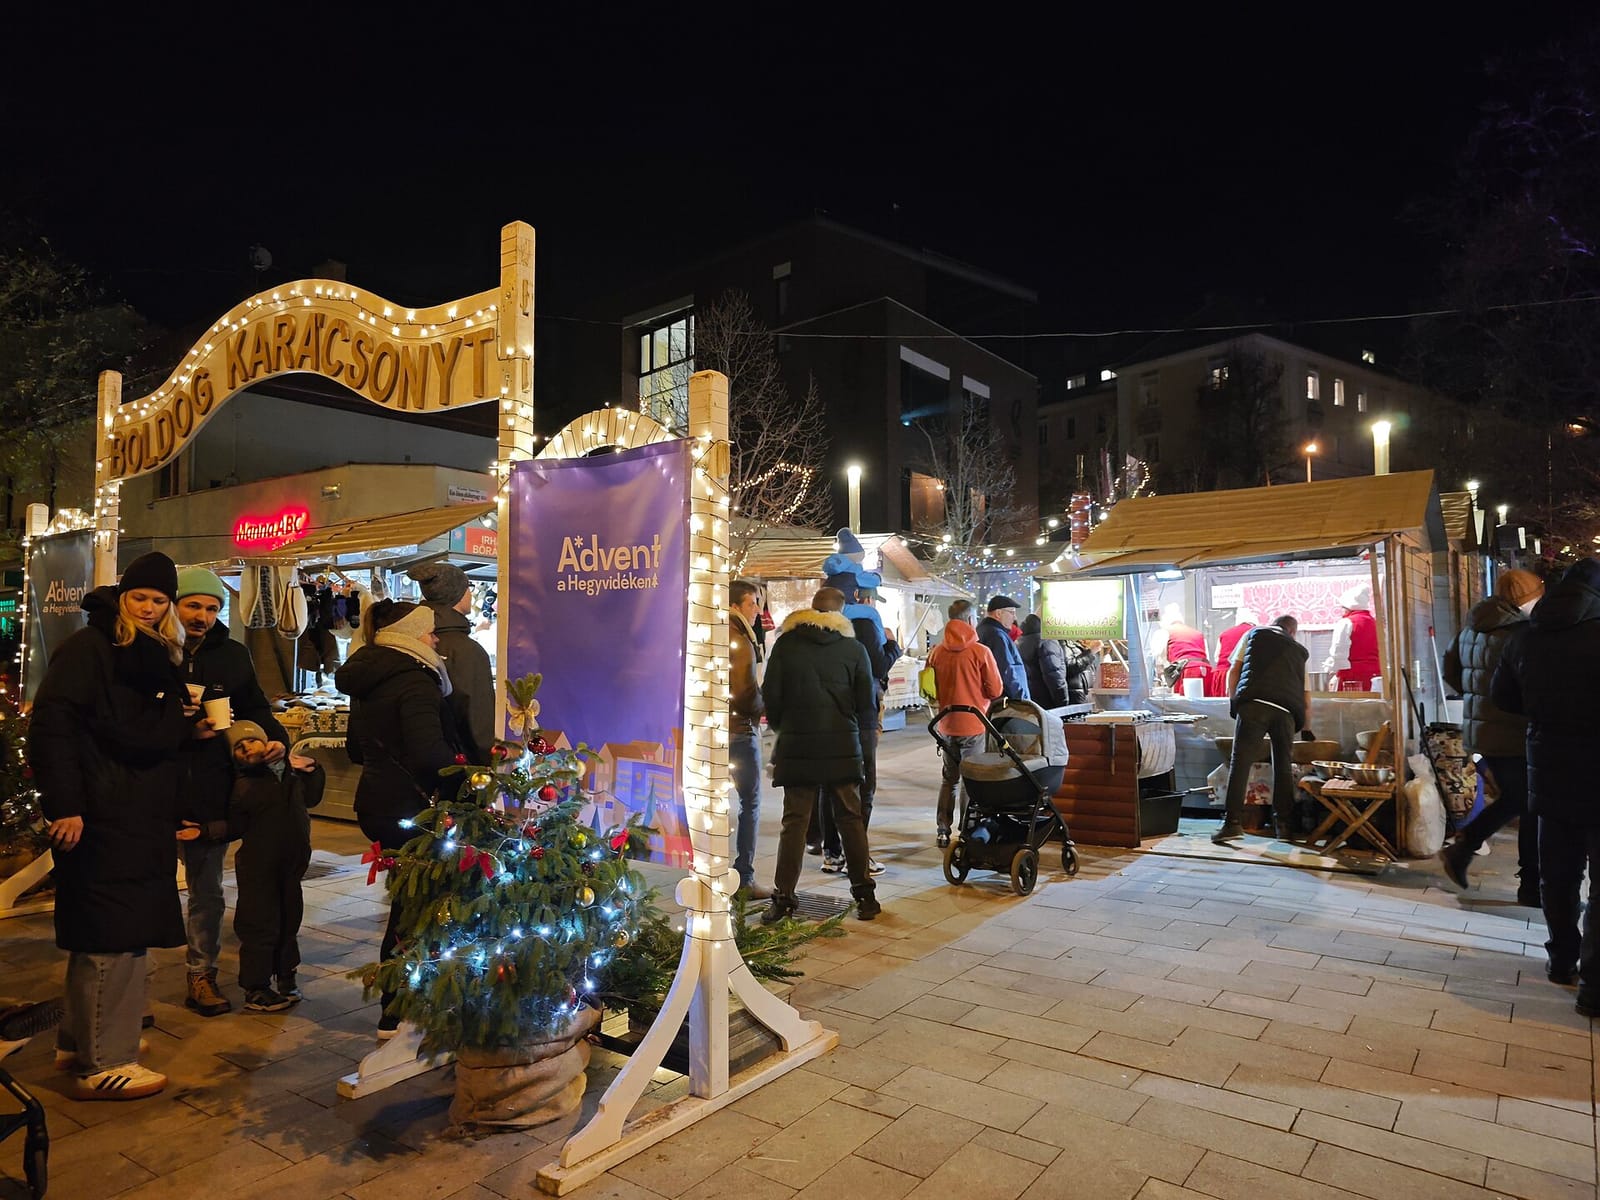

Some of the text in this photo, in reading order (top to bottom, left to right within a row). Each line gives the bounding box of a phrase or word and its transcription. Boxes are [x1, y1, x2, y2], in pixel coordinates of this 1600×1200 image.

[110, 312, 495, 477] BOLDOG KARÁCSONYT
[276, 513, 304, 535] ABC
[481, 535, 497, 546] IRH
[557, 534, 661, 572] Advent
[557, 572, 652, 596] a Hegyvidéken
